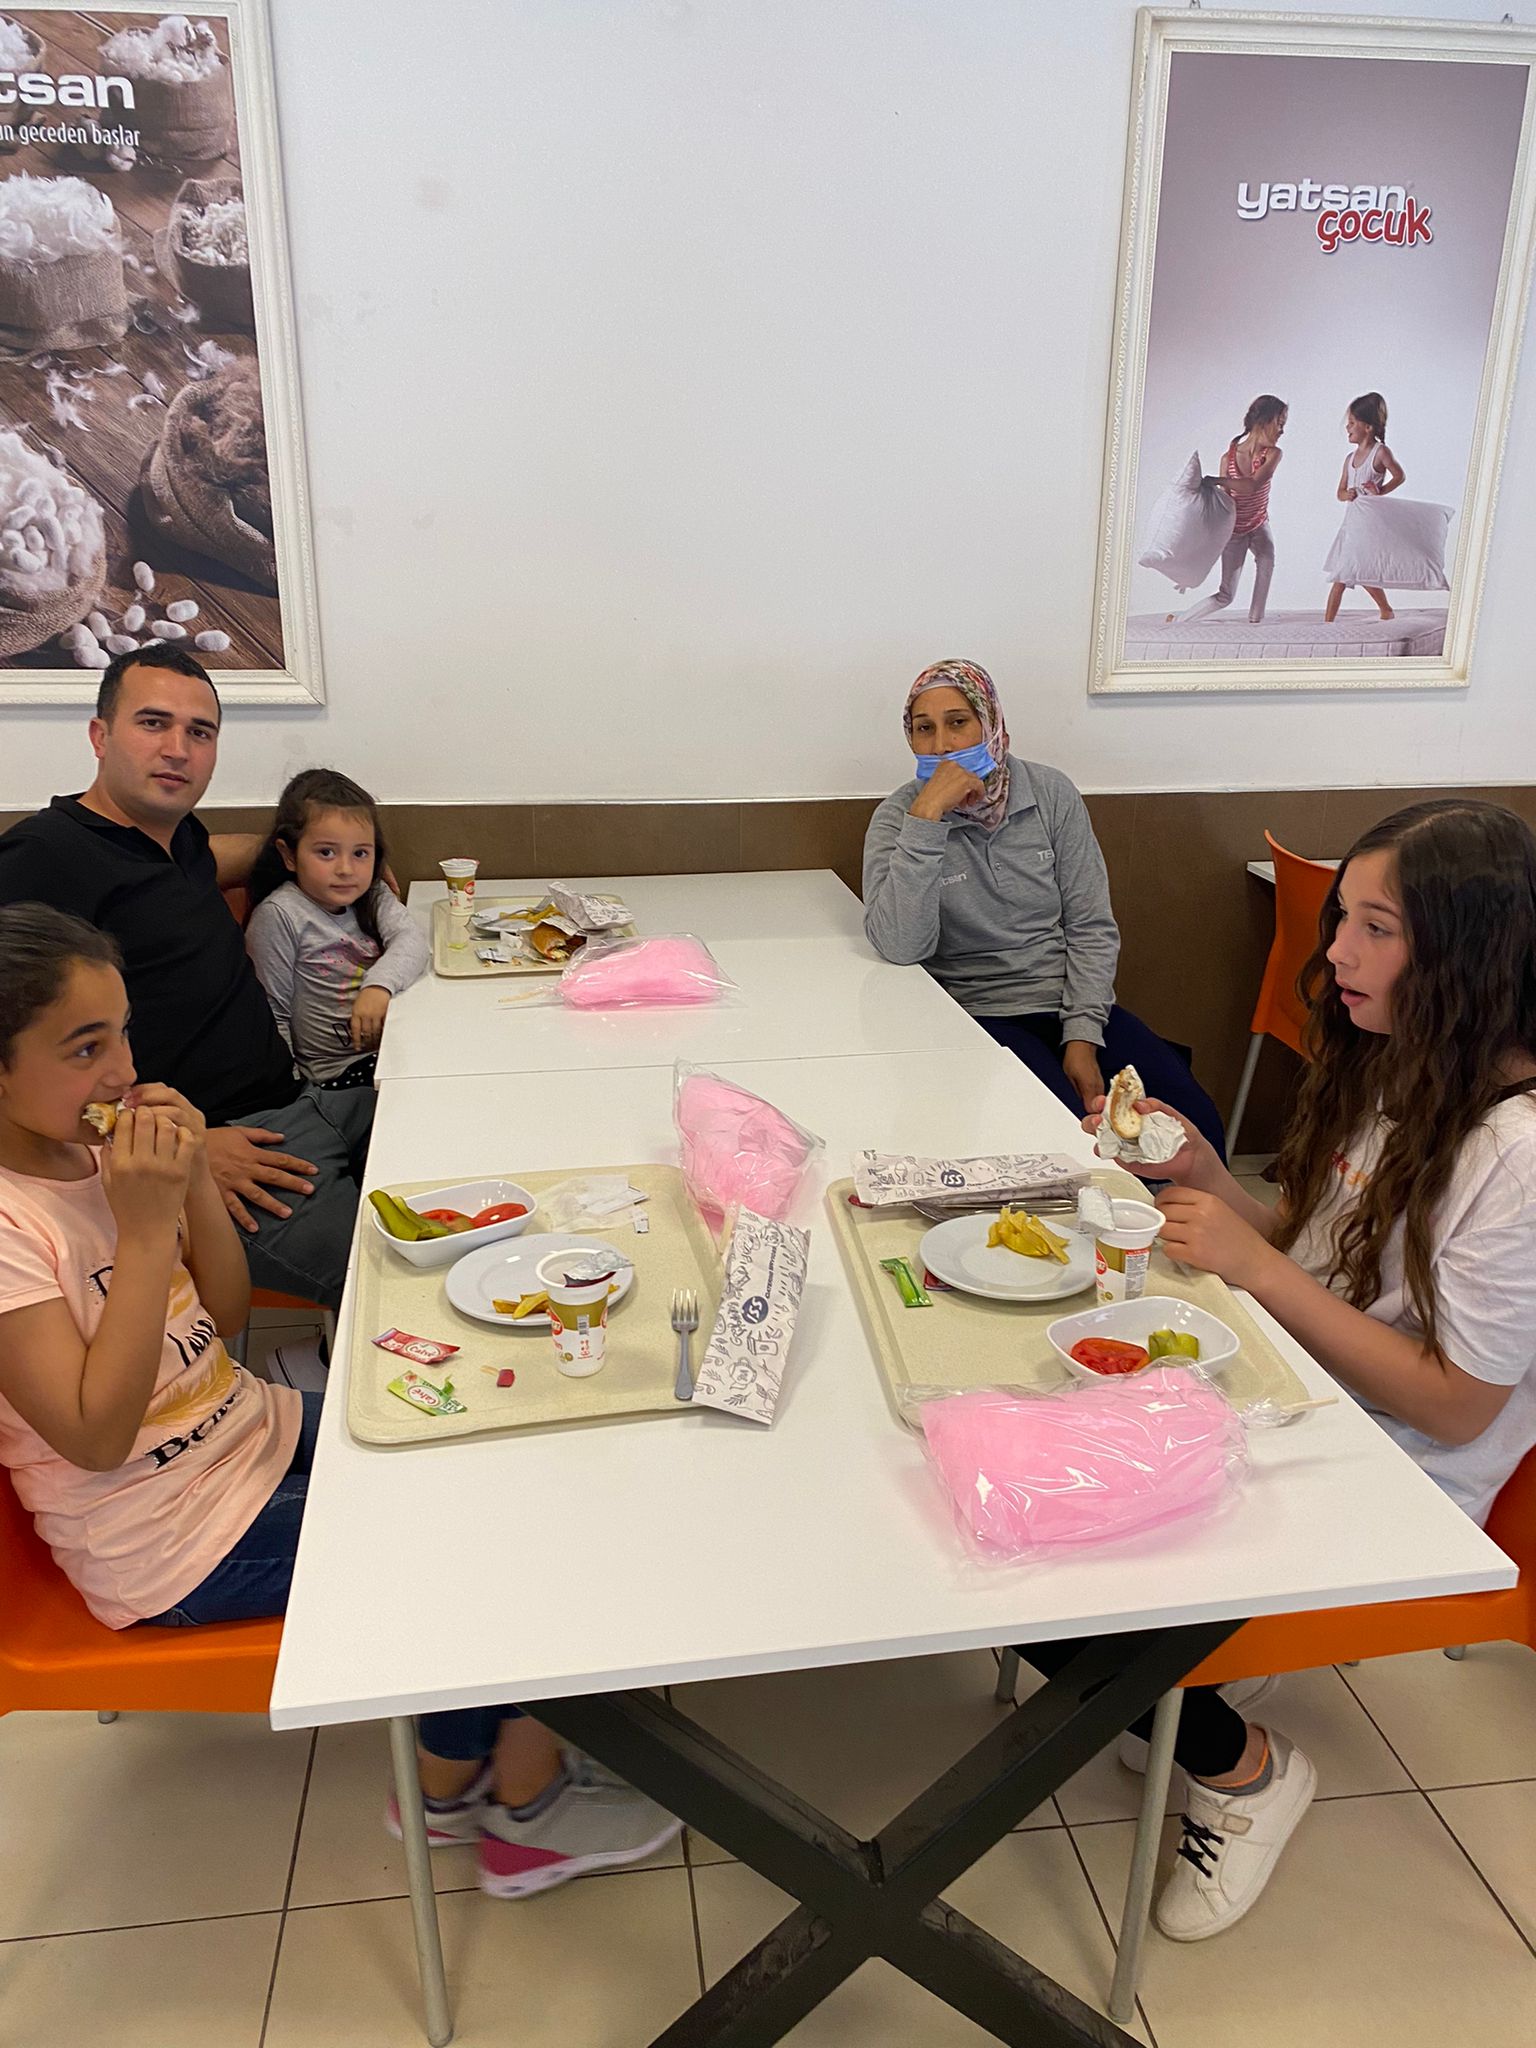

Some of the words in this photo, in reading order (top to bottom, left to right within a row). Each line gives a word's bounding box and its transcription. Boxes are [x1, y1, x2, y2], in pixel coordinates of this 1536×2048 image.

[19, 122, 88, 146] geceden
[93, 123, 141, 147] başlar
[1237, 178, 1406, 219] yatsan
[1316, 196, 1434, 254] çocuk
[942, 1172, 963, 1186] ISS
[746, 1297, 764, 1324] ISS
